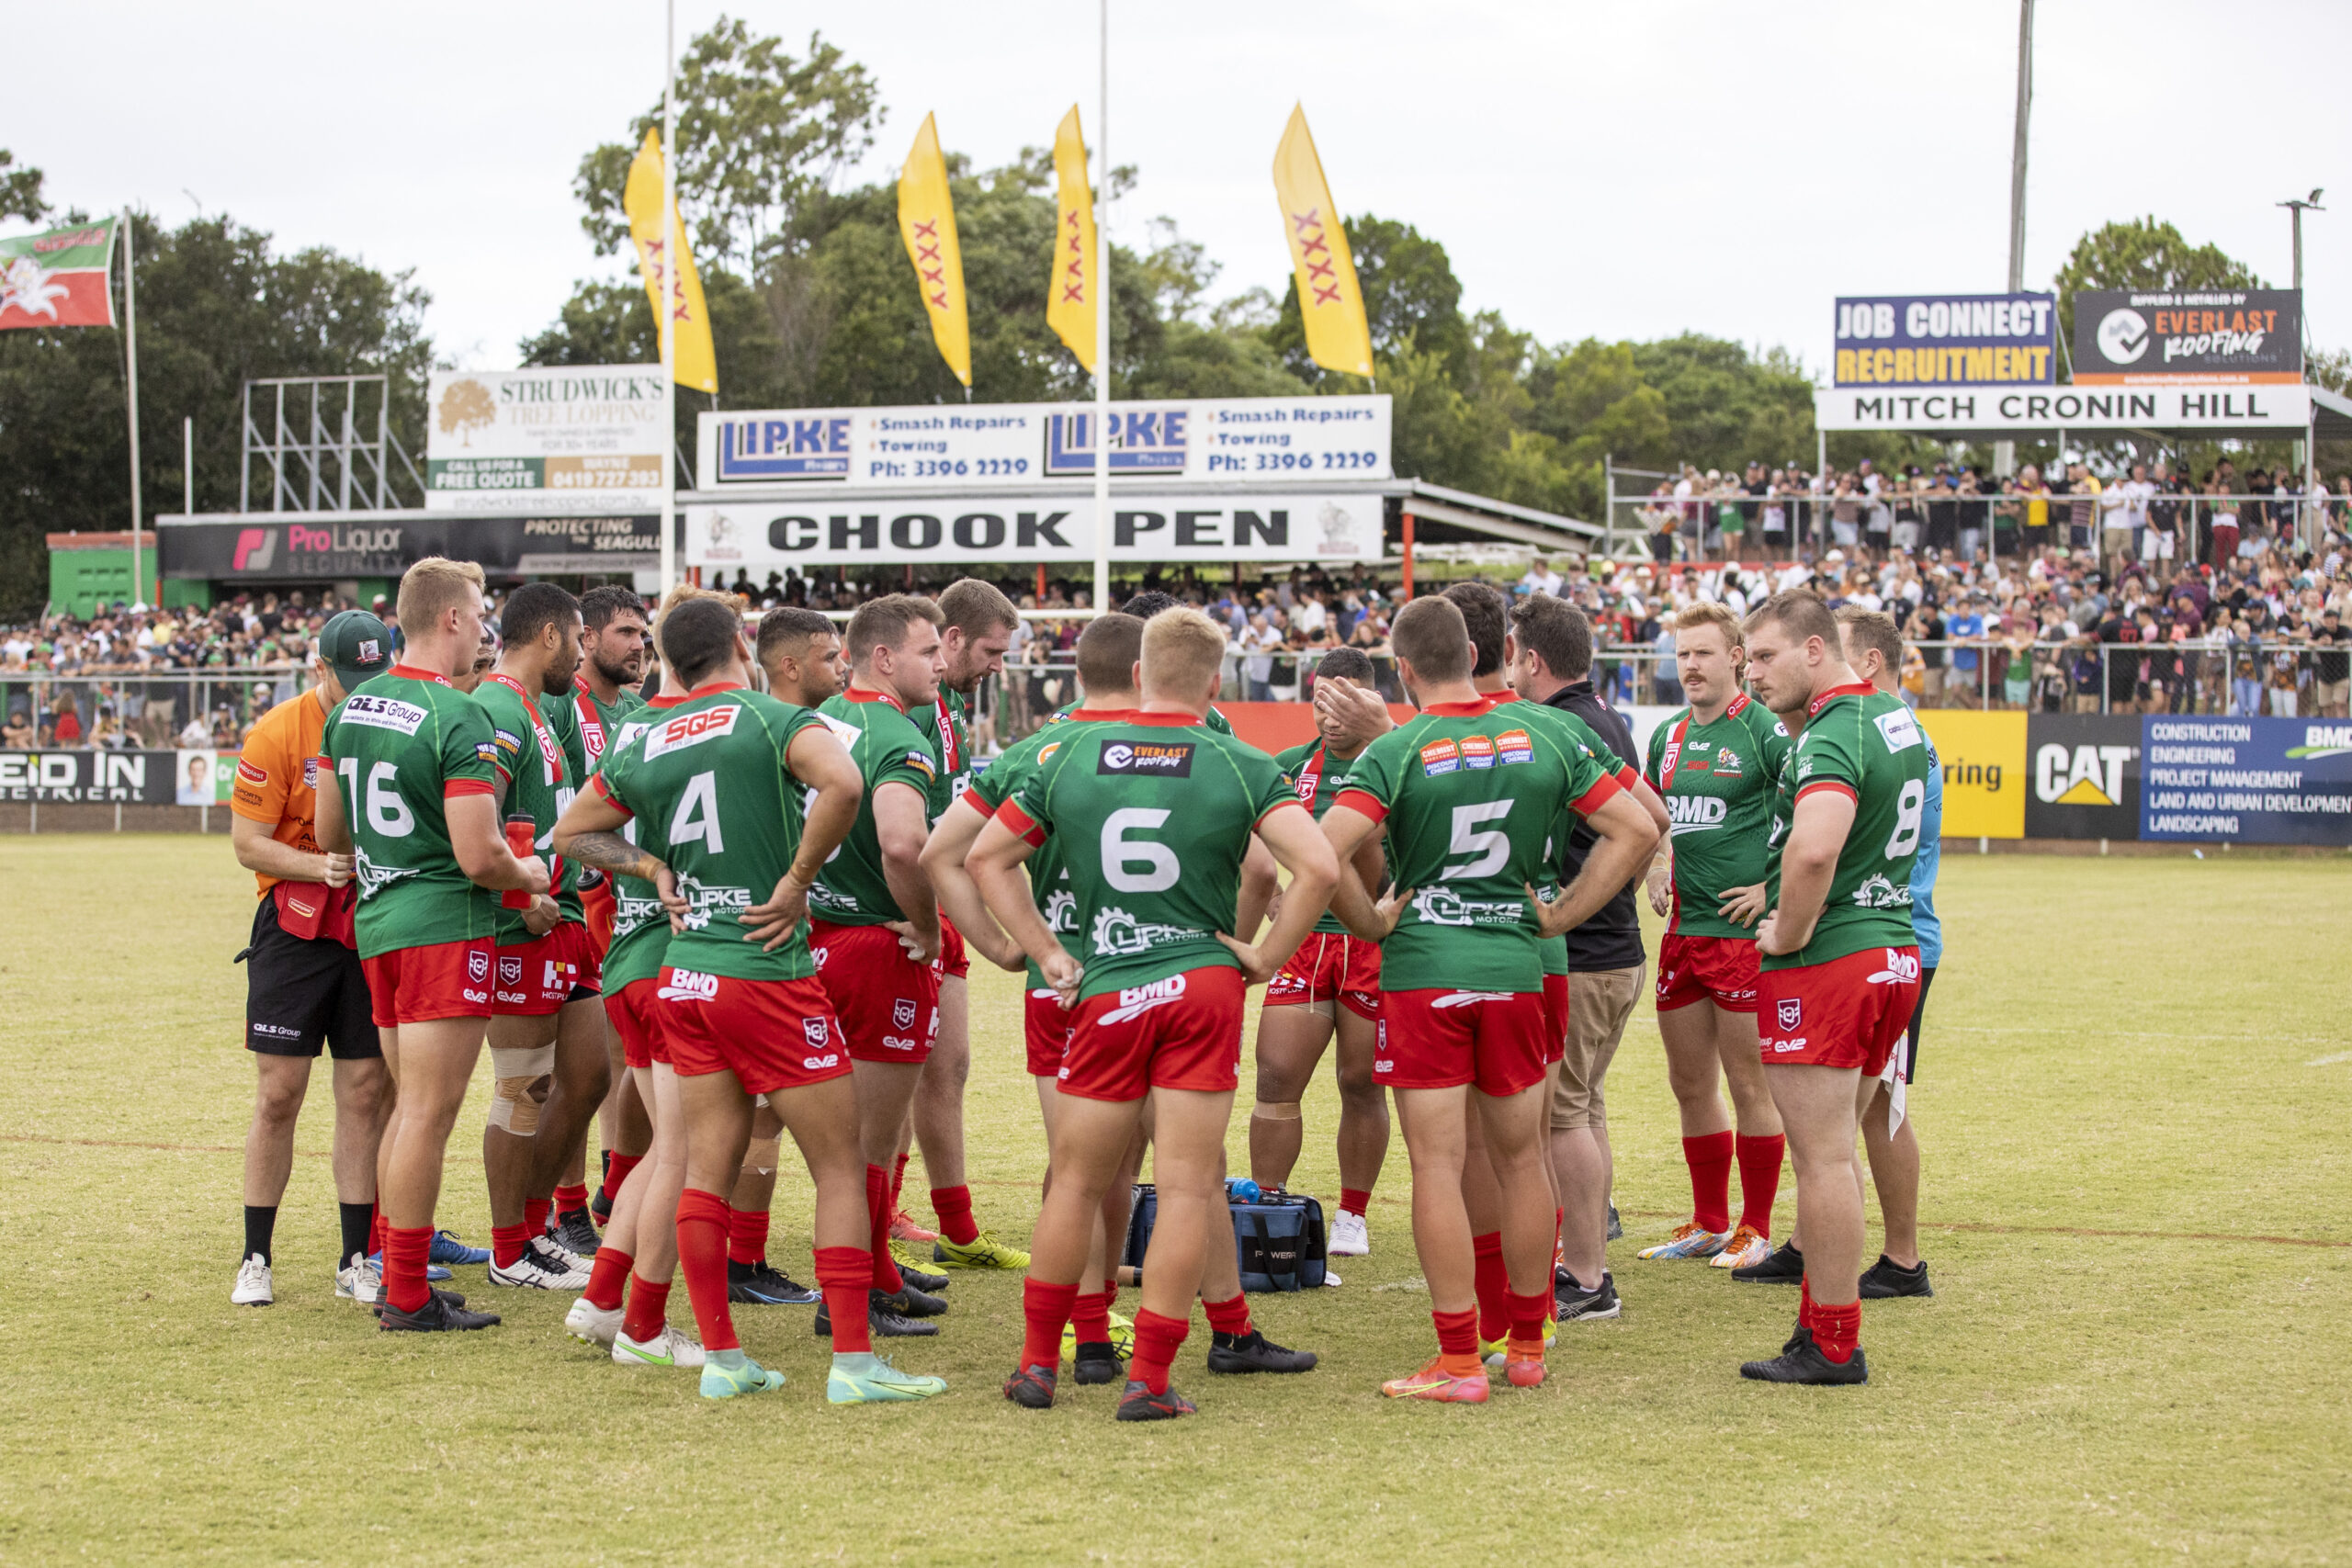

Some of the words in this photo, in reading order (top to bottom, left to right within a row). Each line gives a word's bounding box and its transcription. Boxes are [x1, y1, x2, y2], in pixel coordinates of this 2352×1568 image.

[913, 217, 950, 311] XXXX
[1061, 210, 1084, 305] XXXX
[1291, 208, 1341, 306] XXXX
[1837, 303, 1895, 340] JOB
[1905, 300, 2052, 338] CONNECT
[2155, 310, 2278, 334] EVERLAST
[2164, 327, 2266, 363] ROOFING
[1837, 345, 2051, 383] RECRUITMENT
[500, 376, 663, 404] STRUDWICK'S
[510, 404, 560, 425] TREE
[566, 401, 656, 424] LOPPING
[1218, 409, 1286, 424] Smash
[1293, 408, 1374, 423] Repairs
[1856, 396, 1975, 421] MITCH
[1999, 394, 2155, 419] CRONIN
[2181, 394, 2268, 419] HILL
[879, 417, 944, 432] Smash
[950, 415, 1026, 431] Repairs
[722, 419, 850, 475] LIPKE
[879, 440, 948, 454] Towing
[1218, 433, 1291, 446] Towing
[447, 460, 477, 471] CALL
[870, 461, 905, 478] Ph:
[913, 459, 968, 477] 3396
[977, 458, 1029, 476] 2229
[1208, 455, 1247, 471] Ph:
[1255, 453, 1313, 470] 3396
[1323, 451, 1377, 468] 2229
[435, 472, 477, 490] FREE
[479, 471, 535, 489] QUOTE
[524, 518, 634, 536] PROTECTING
[768, 512, 1073, 551] CHOOK
[1114, 510, 1289, 547] PEN
[288, 525, 402, 558] ProLiquor
[287, 556, 403, 574] SECURITY
[347, 697, 388, 714] QLS
[387, 703, 422, 723] Group
[664, 707, 734, 744] SQS
[2151, 723, 2251, 742] CONSTRUCTION
[1134, 746, 1189, 758] EVERLAST
[1422, 745, 1455, 758] CHEMIST
[1461, 742, 1491, 750] CHEMIST
[1498, 736, 1528, 746] CHEMIST
[2150, 746, 2235, 764] ENGINEERING
[93, 751, 145, 788] IN
[1943, 759, 2002, 793] ring
[2036, 743, 2132, 806] CAT
[2150, 768, 2208, 787] PROJECT
[2211, 770, 2303, 789] MANAGEMENT
[338, 757, 415, 838] 16
[2149, 792, 2185, 809] LAND
[2188, 793, 2216, 810] AND
[2218, 794, 2263, 812] URBAN
[2265, 795, 2352, 814] DEVELOPMEN
[669, 770, 724, 854] 4
[1665, 795, 1727, 824] BMD
[1885, 779, 1924, 861] 8
[2149, 815, 2239, 834] LANDSCAPING
[1100, 807, 1181, 893] 6
[1439, 798, 1515, 881] 5
[689, 888, 752, 908] LIPKE
[713, 907, 746, 915] MOTOR
[1441, 902, 1522, 919] LIPKE
[1476, 916, 1519, 924] MOTORS
[1155, 932, 1208, 943] MOTORS
[1120, 974, 1186, 1007] BMD
[254, 1022, 277, 1033] QLS
[277, 1026, 301, 1038] Group
